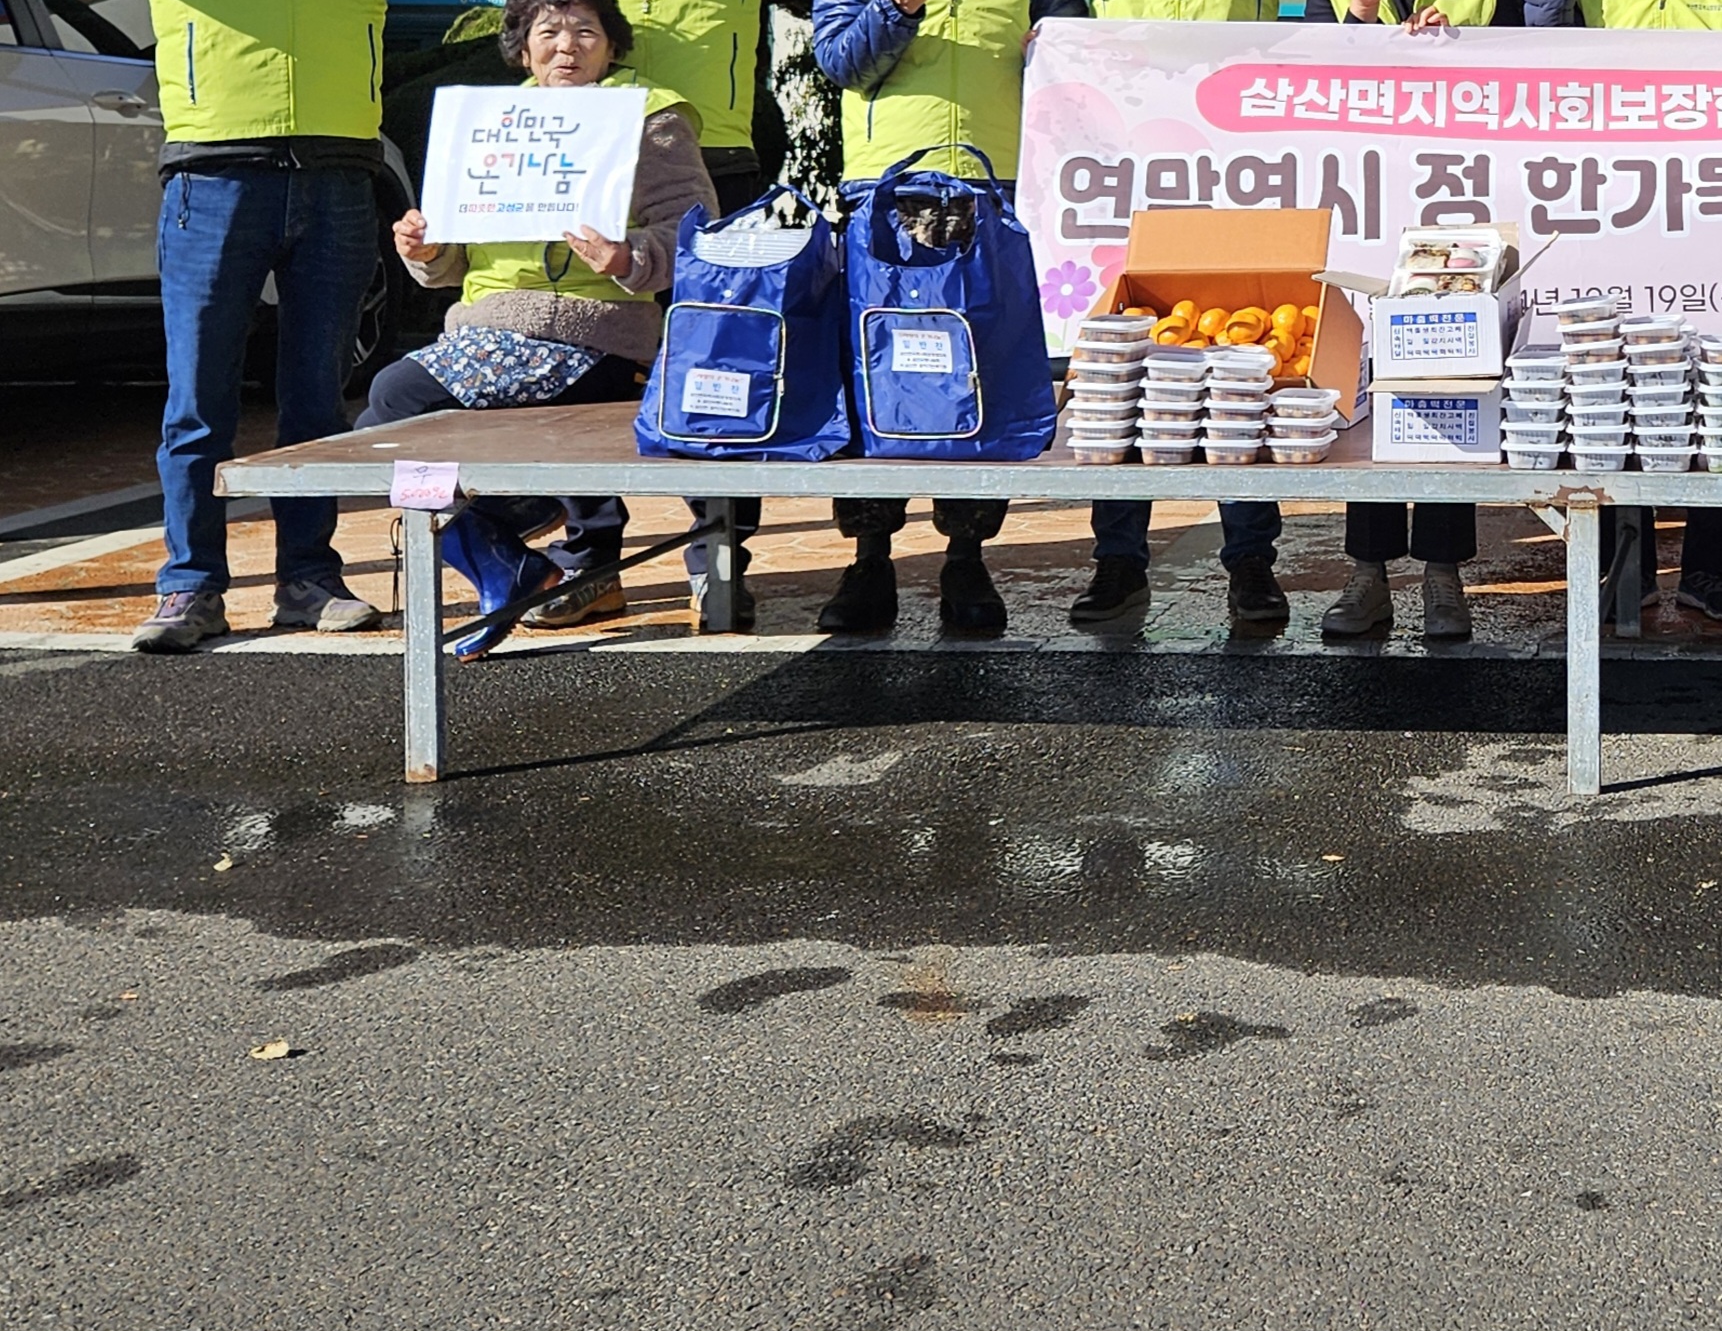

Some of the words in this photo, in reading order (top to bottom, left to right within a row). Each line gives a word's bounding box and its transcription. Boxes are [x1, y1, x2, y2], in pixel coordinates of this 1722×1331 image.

[471, 105, 581, 149] 대한민국
[467, 153, 587, 196] 온기나눔
[1416, 152, 1492, 227] 정
